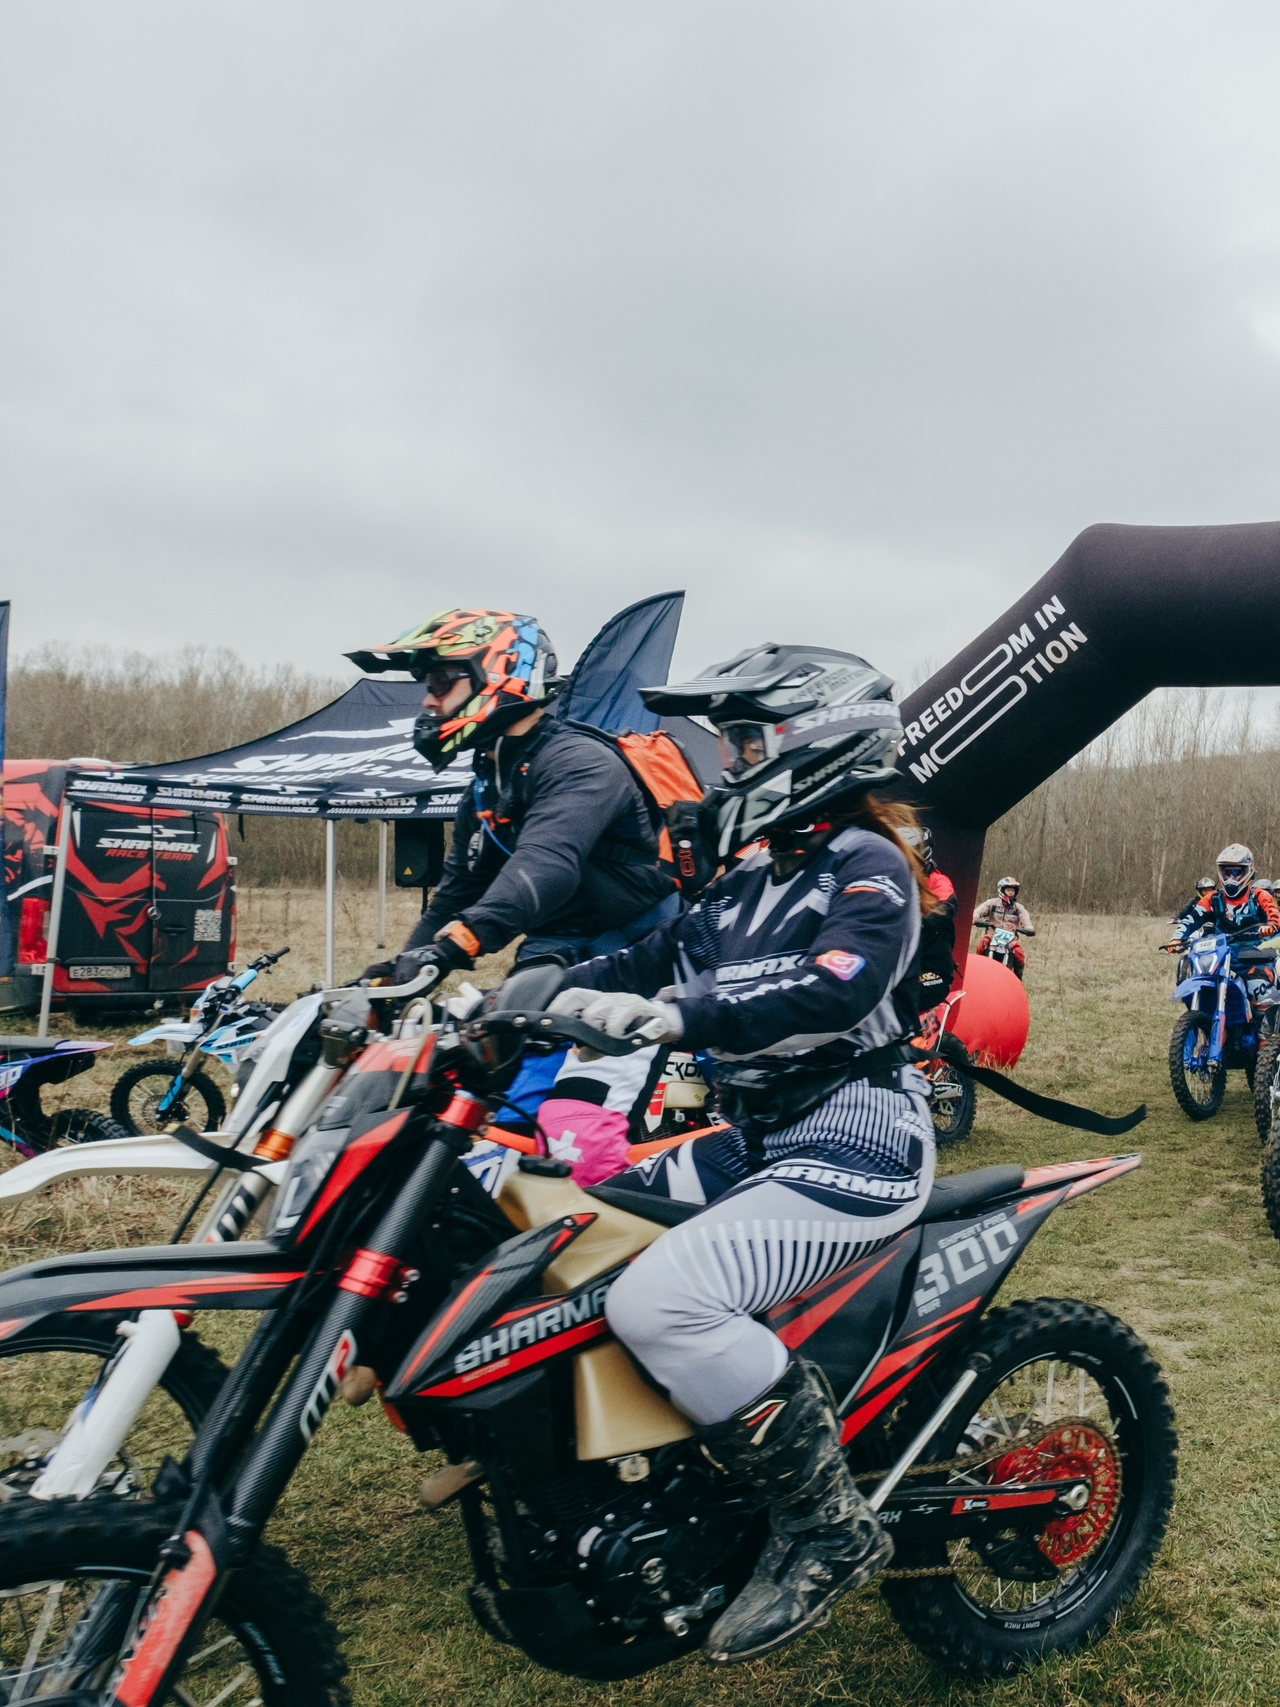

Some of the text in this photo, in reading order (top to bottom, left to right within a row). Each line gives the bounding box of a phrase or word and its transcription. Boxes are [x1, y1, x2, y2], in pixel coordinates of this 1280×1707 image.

[1034, 595, 1066, 630] IN
[908, 622, 1088, 784] MOTION
[69, 780, 148, 794] SHARMAX
[156, 786, 233, 801] SHARMAX
[95, 837, 201, 853] SHARMAX
[105, 849, 194, 861] RACE TEAM
[756, 1166, 920, 1199] HARMAX
[937, 1212, 1007, 1249] EXPERT PRO
[913, 1220, 1019, 1307] 300
[917, 1298, 942, 1317] AIR
[454, 1284, 611, 1375] SHARMA
